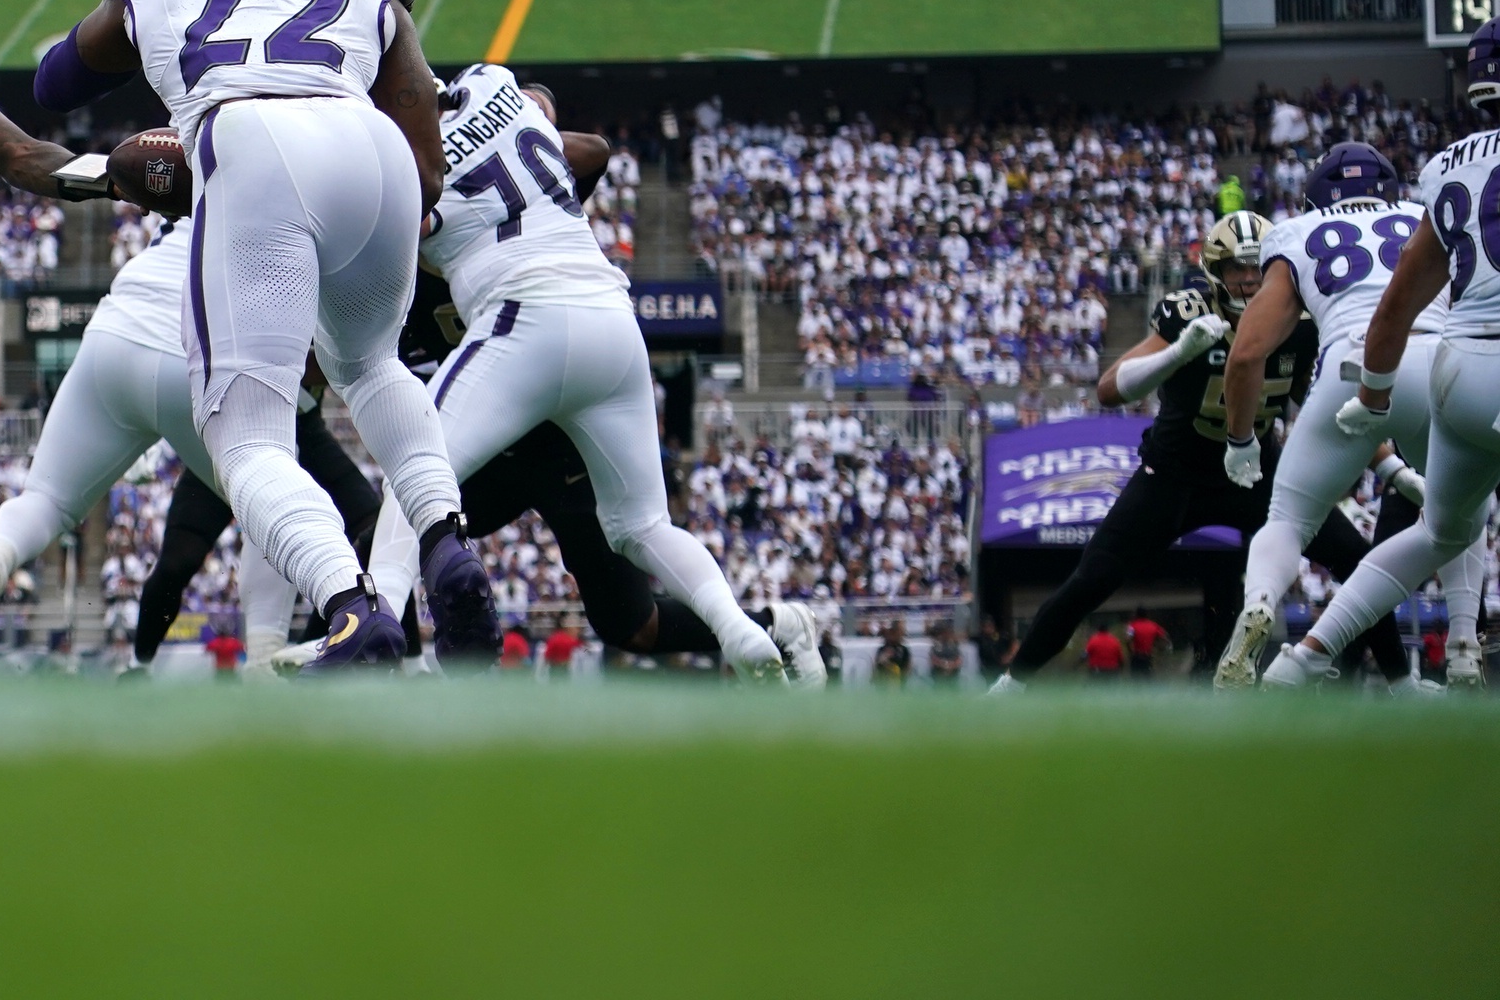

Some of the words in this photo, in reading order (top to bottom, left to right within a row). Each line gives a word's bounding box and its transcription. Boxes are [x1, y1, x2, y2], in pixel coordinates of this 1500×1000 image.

[148, 174, 171, 190] NFL
[451, 127, 584, 243] 70
[1305, 214, 1422, 297] 88
